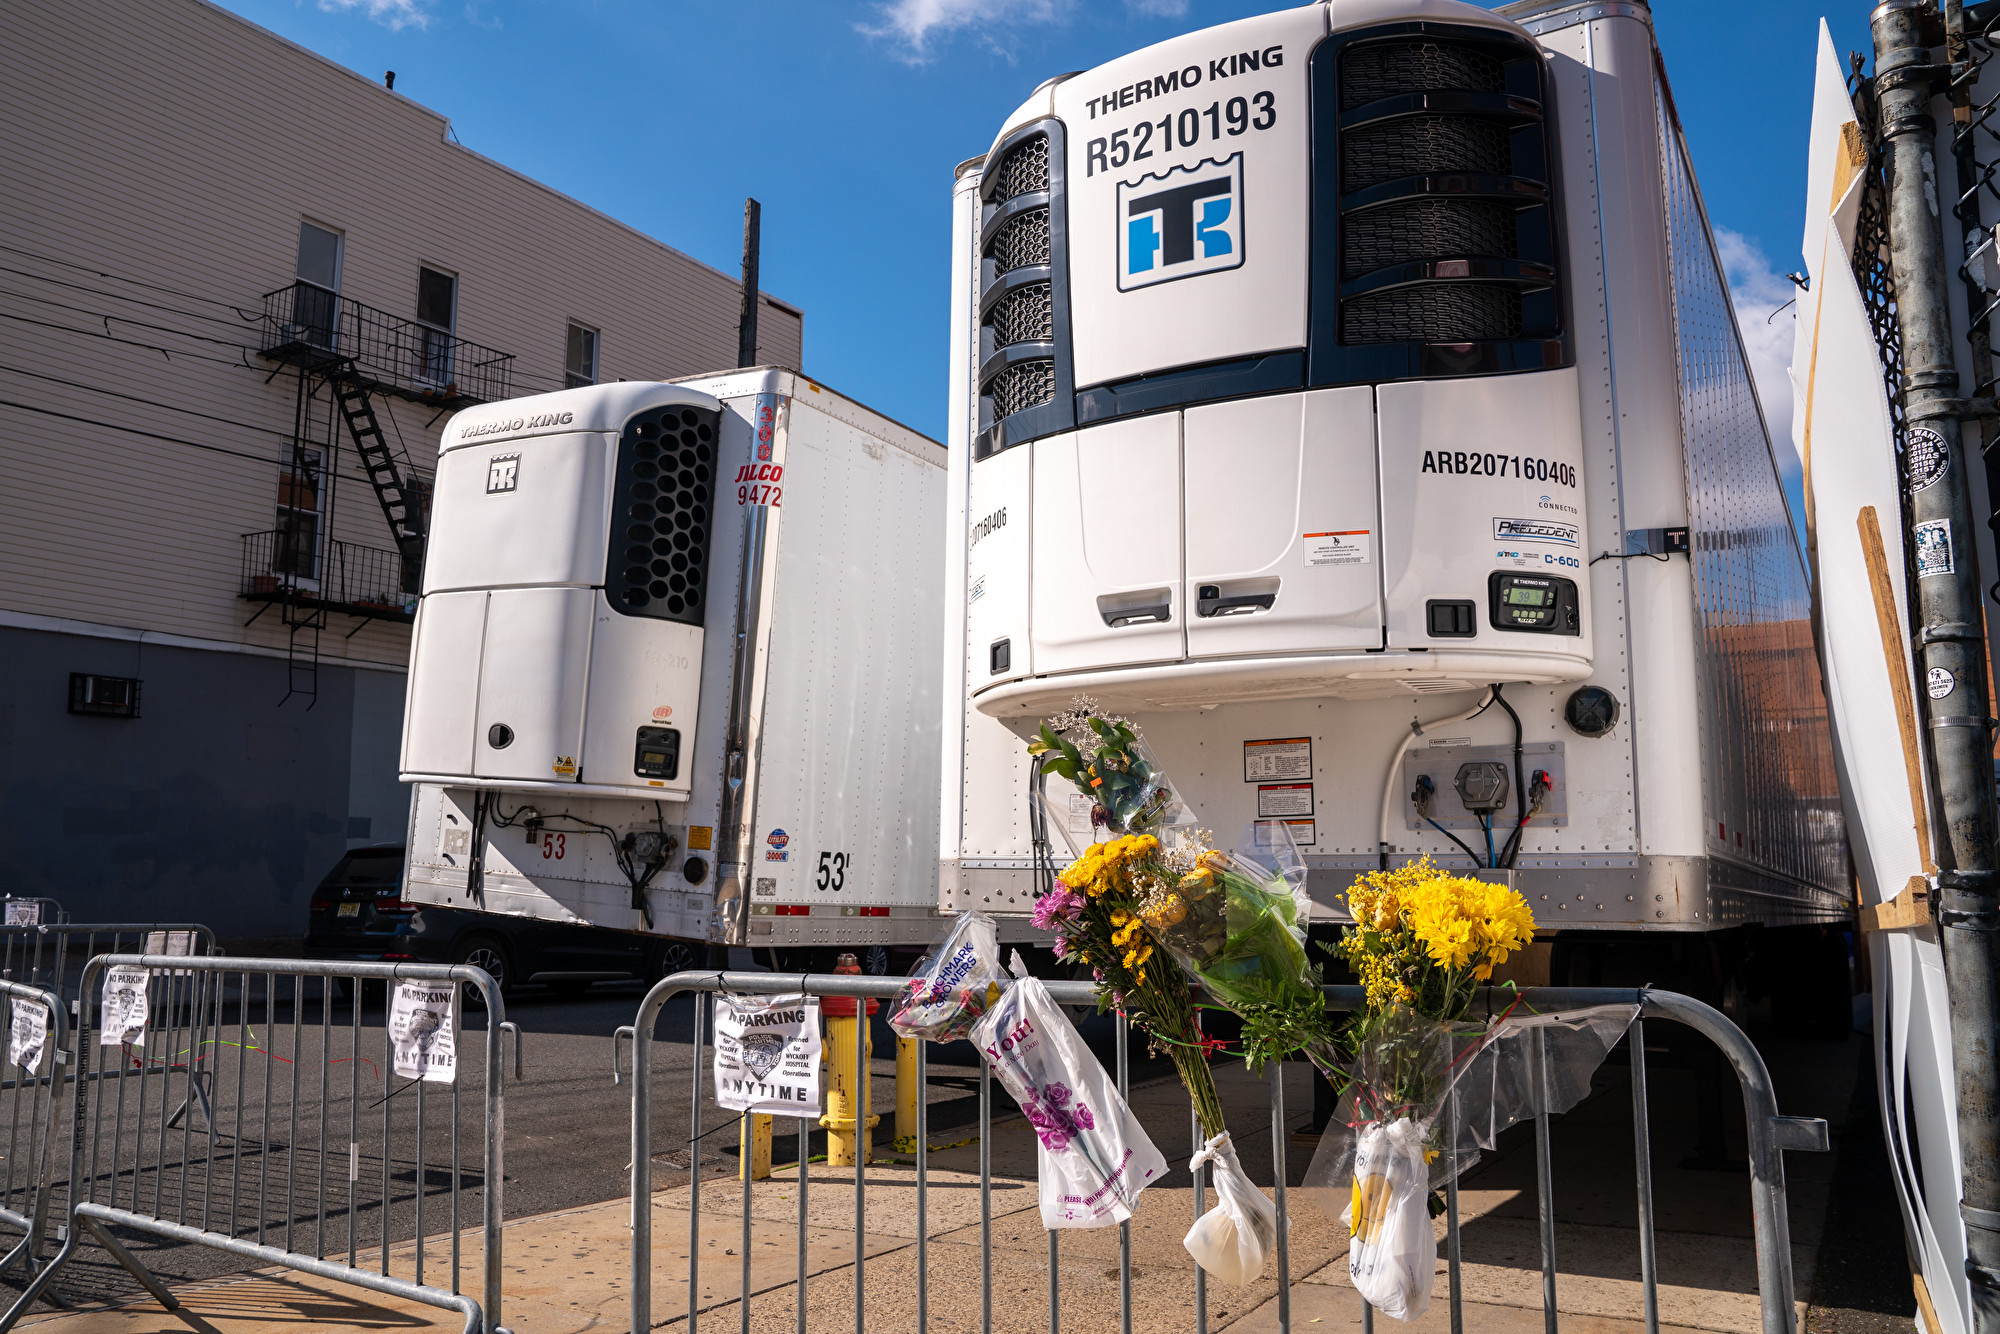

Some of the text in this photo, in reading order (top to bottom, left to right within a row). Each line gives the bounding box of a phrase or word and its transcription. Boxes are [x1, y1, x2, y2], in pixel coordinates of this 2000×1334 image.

[1086, 45, 1283, 120] THERMO KING
[1087, 90, 1277, 178] R5210193
[461, 412, 573, 438] THERMO KING
[1914, 429, 1947, 454] WANTED
[735, 464, 783, 483] JILCO
[1422, 450, 1576, 488] ARB207160406
[1924, 460, 1948, 485] Service
[738, 485, 782, 507] 9472
[1538, 502, 1577, 514] CONNECTED
[1498, 521, 1577, 539] PRECEDENT
[1544, 554, 1579, 568] C-600
[543, 833, 566, 860] 53
[768, 836, 790, 844] UTILITY
[766, 851, 787, 861] 3000R
[109, 974, 117, 983] NO
[936, 955, 977, 1008] GROWERS
[402, 988, 412, 999] NO
[739, 1010, 805, 1027] PARKING
[986, 1018, 1034, 1061] You!
[1024, 1040, 1040, 1053] Day
[782, 1070, 811, 1078] Operations
[723, 1078, 807, 1102] ANYTIME
